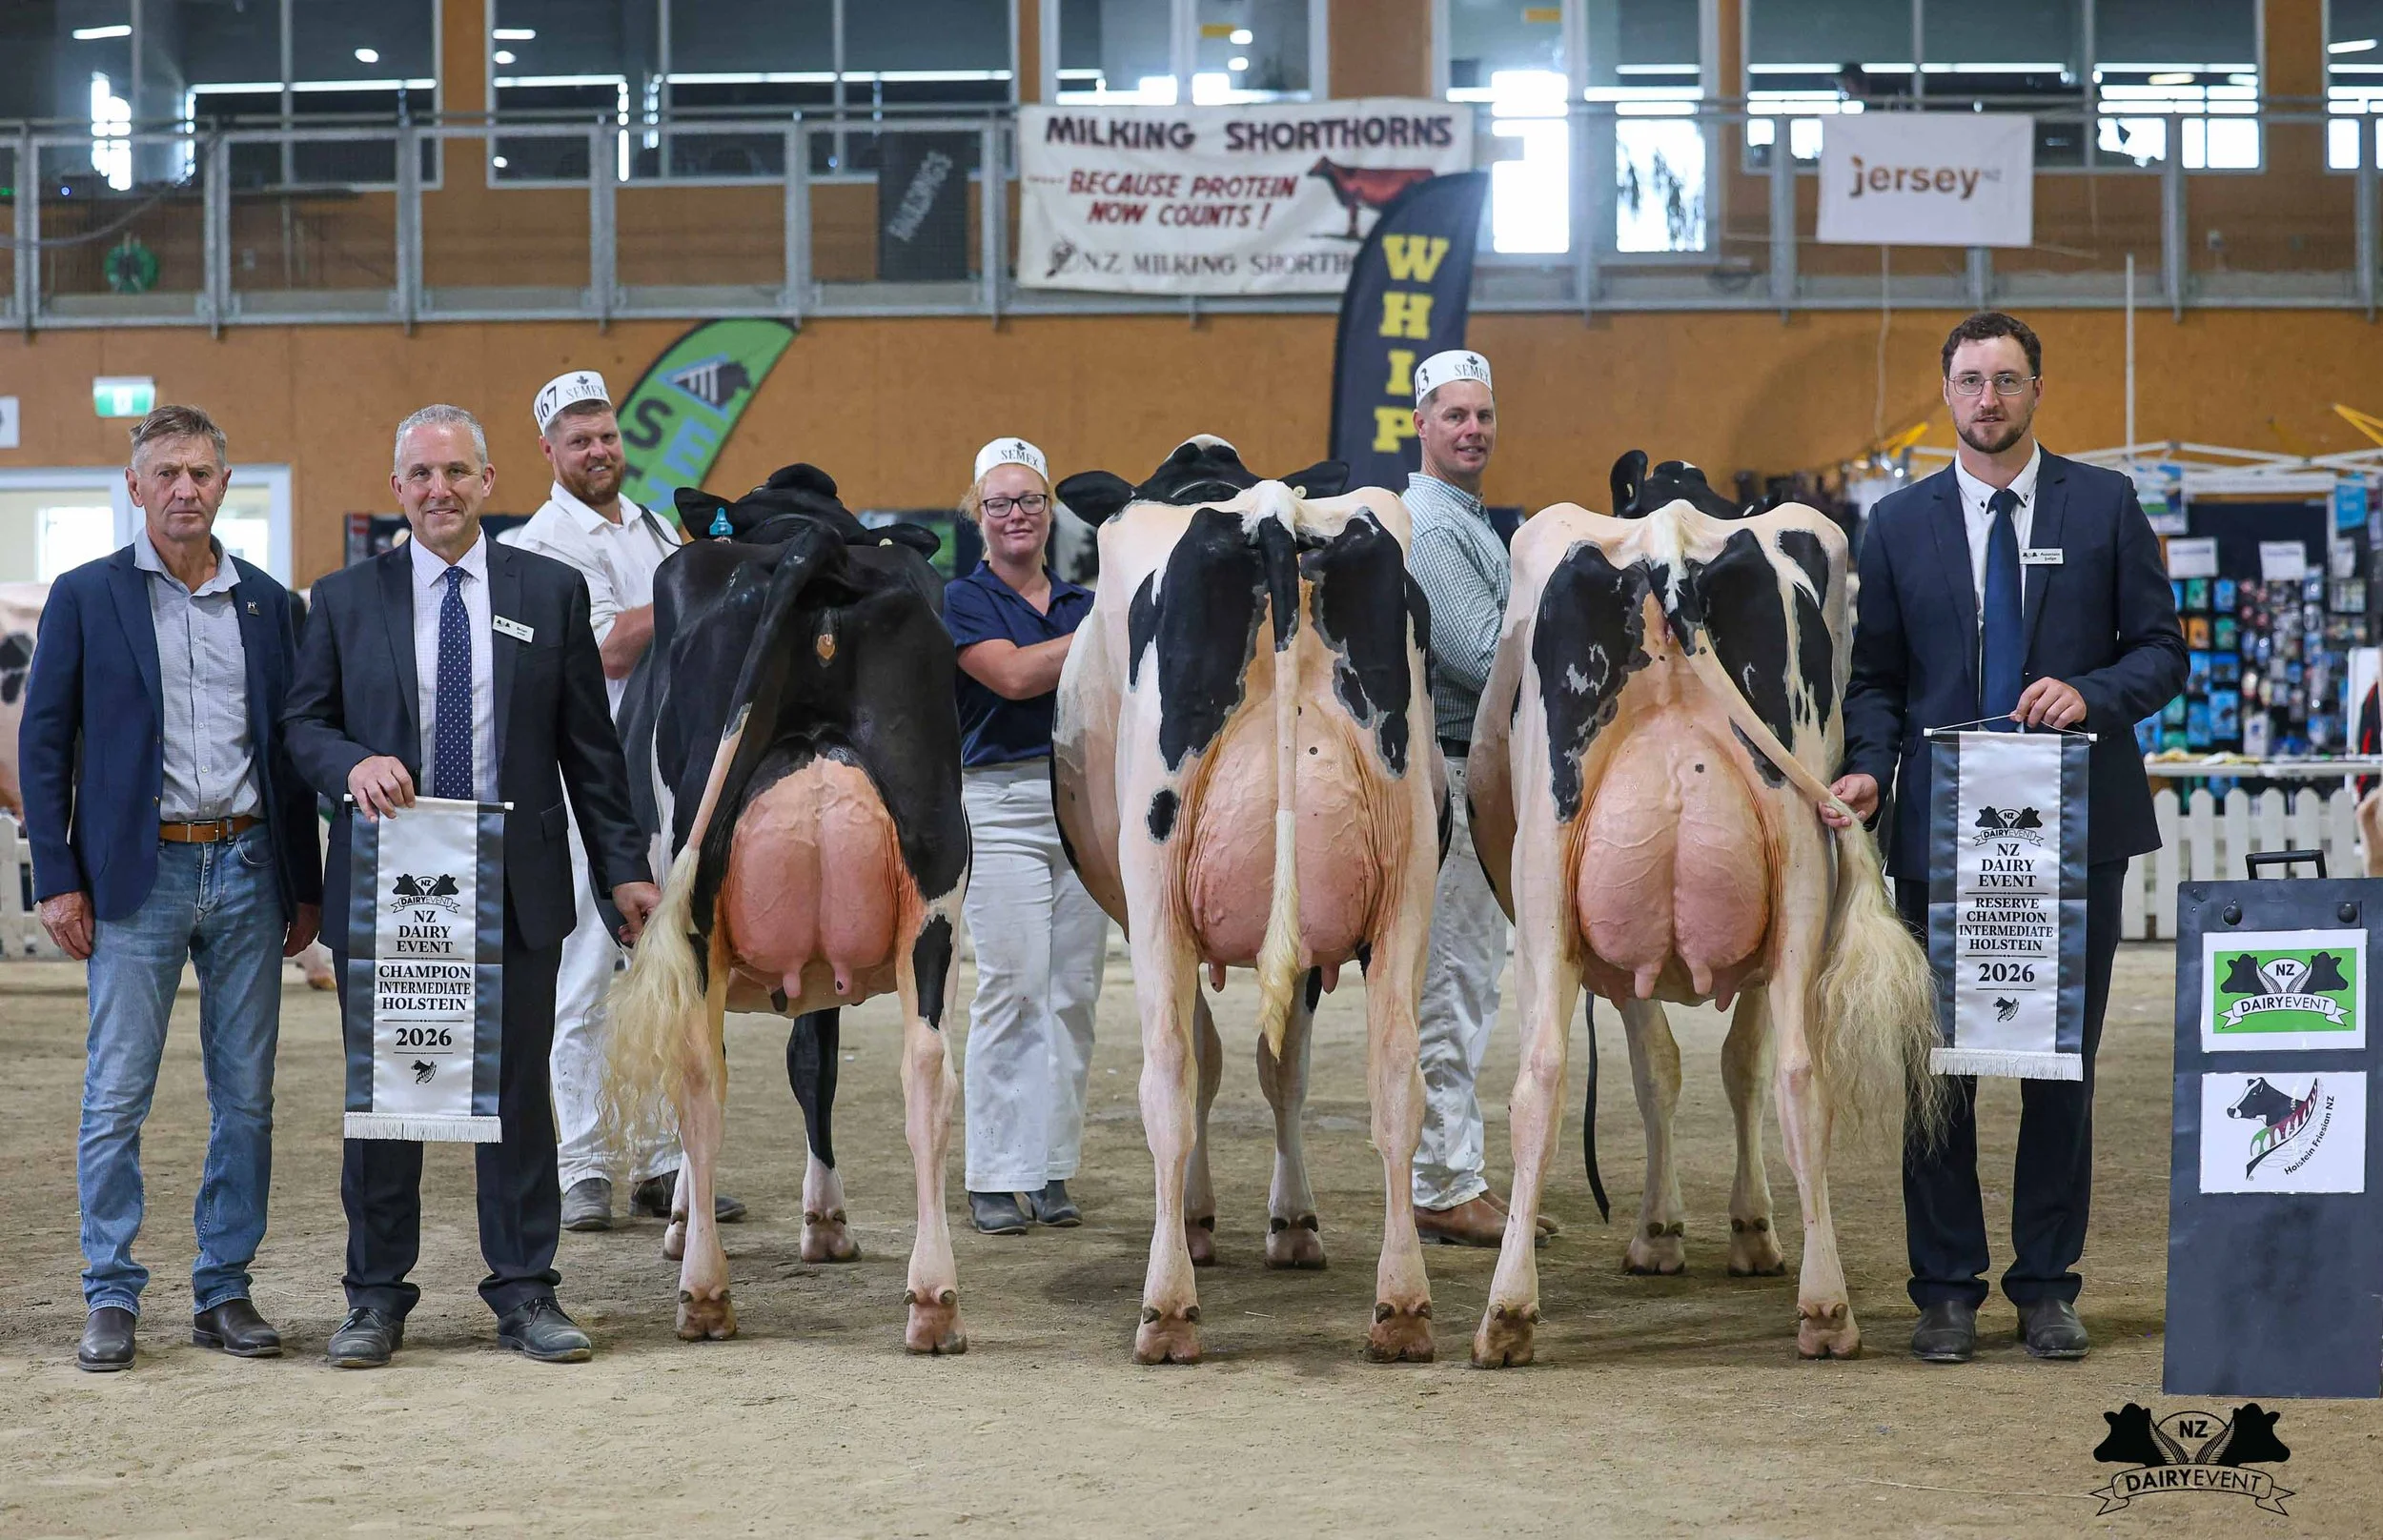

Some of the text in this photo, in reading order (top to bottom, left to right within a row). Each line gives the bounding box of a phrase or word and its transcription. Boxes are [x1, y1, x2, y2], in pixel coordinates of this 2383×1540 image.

[1046, 115, 1454, 152] MILKING SHORTHORNS
[1069, 170, 1299, 200] BECAUSE PROTEIN
[1087, 201, 1148, 226] NOW
[1132, 252, 1237, 274] MILKING
[1001, 449, 1039, 469] SEMEX
[1996, 843, 2020, 857] NZ
[1981, 859, 2035, 873] DAIRY
[1978, 874, 2037, 888] EVENT
[1975, 898, 2040, 909] RESERVE
[413, 911, 437, 923] NZ
[1965, 911, 2047, 924] CHAMPION
[398, 925, 452, 939] DAIRY
[1959, 924, 2054, 938] INTERMEDIATE
[396, 941, 453, 954] EVENT
[1968, 939, 2044, 951] HOLSTEIN
[378, 965, 471, 980] CHAMPION
[1978, 962, 2035, 983] 2026
[2275, 963, 2295, 977] NZ
[378, 982, 471, 996] INTERMEDIATE
[381, 998, 467, 1011] HOLSTEIN
[2241, 996, 2330, 1013] DAIRYEVENT
[395, 1027, 453, 1047] 2026
[2284, 1096, 2334, 1176] Holstein Friesian NZ
